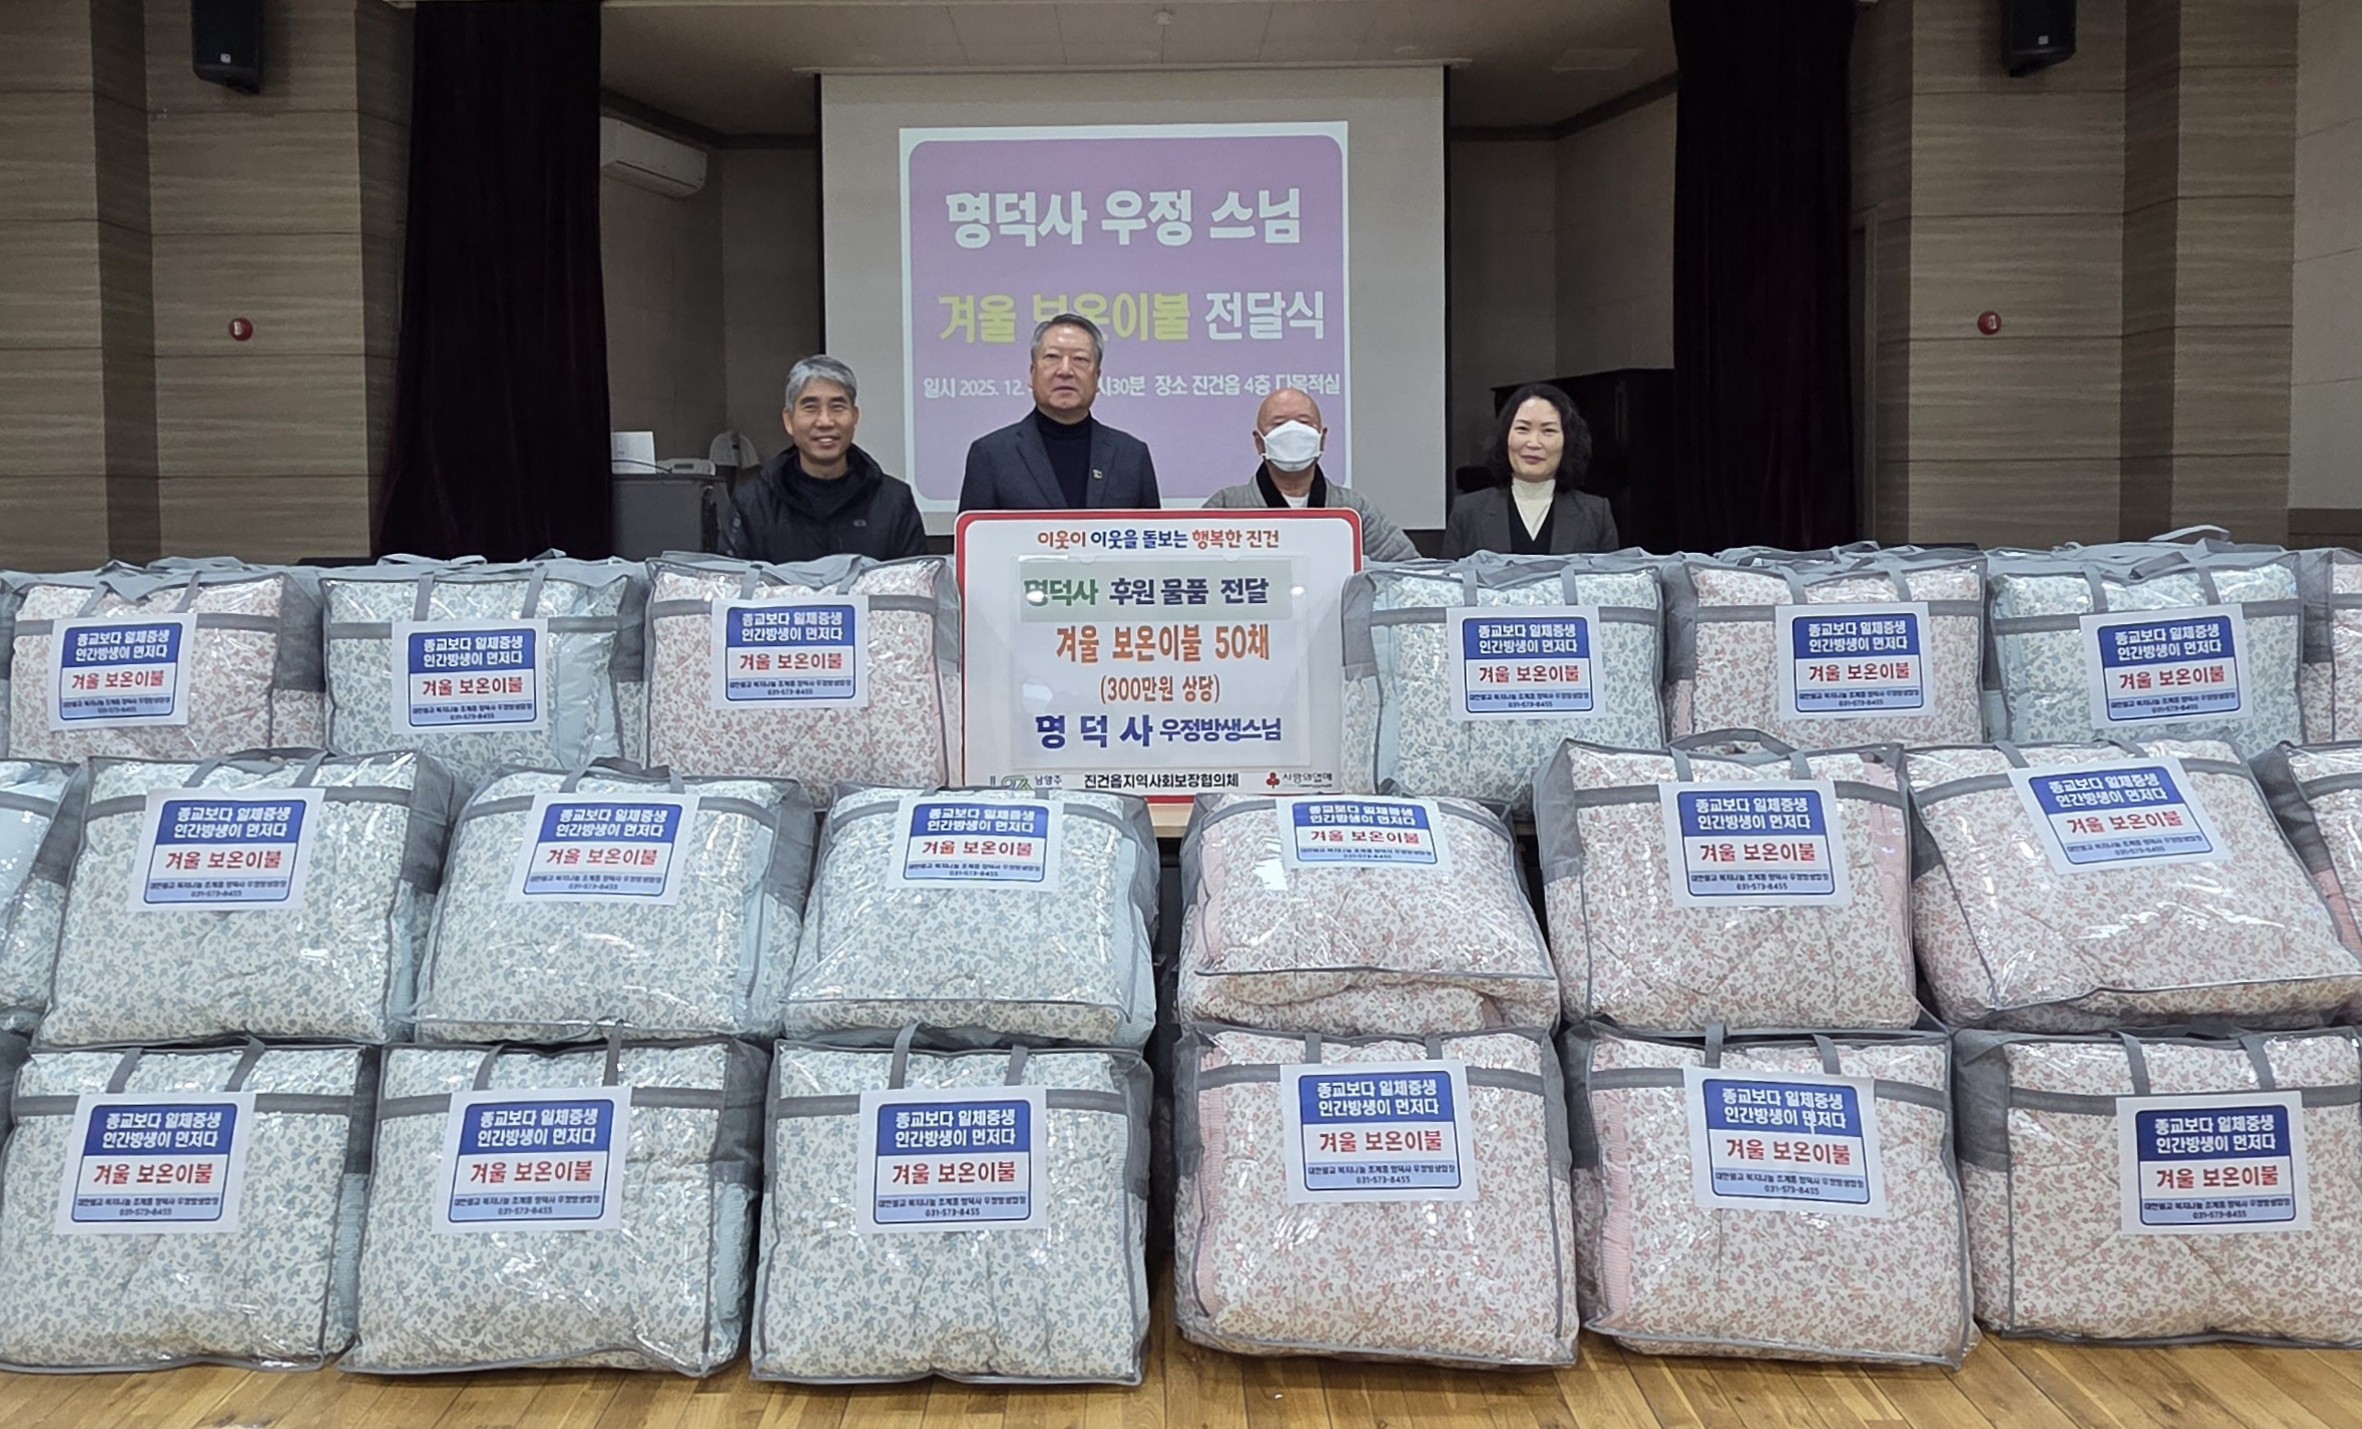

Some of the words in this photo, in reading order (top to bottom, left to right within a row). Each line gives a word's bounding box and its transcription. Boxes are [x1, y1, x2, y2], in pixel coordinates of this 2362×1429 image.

[946, 191, 1087, 248] 명덕사
[1101, 190, 1192, 245] 우정
[1210, 188, 1300, 244] 스님
[939, 294, 1016, 343] 겨울
[1205, 291, 1324, 340] 전달식
[924, 377, 955, 398] 일시
[960, 380, 999, 397] 2025.
[1155, 375, 1188, 396] 장소
[1192, 374, 1240, 396] 진건읍
[1244, 374, 1271, 396] 4층
[1038, 531, 1086, 548] 이웃이
[1091, 530, 1139, 549] 이웃을
[1142, 531, 1188, 549] 돌보는
[1192, 529, 1242, 549] 행복한
[1246, 529, 1280, 548] 진건
[1024, 579, 1099, 606] 명덕사
[1109, 578, 1155, 605] 후원
[1161, 578, 1209, 605] 물품
[1220, 578, 1269, 604] 전달
[741, 612, 790, 627] 종교보다
[793, 610, 842, 625] 일체중생
[1808, 622, 1856, 637] 종교보다
[1859, 620, 1907, 635] 일체중생
[741, 627, 801, 642] 인간방생이
[805, 626, 842, 640] 먼저다
[1478, 624, 1526, 638] 종교보다
[1529, 623, 1576, 637] 일체중생
[2115, 627, 2166, 645] 종교보다
[2169, 623, 2220, 640] 일체중생
[423, 637, 471, 652] 종교보다
[475, 634, 522, 650] 일체중생
[1056, 625, 1099, 662] 겨울
[1113, 624, 1202, 662] 보온이불
[1215, 623, 1270, 660] 50채
[1478, 639, 1538, 653] 인간방생이
[1542, 638, 1578, 652] 먼저다
[1809, 637, 1869, 652] 인간방생이
[1872, 635, 1908, 650] 먼저다
[2116, 642, 2180, 661] 인간방생이
[2183, 638, 2222, 655] 먼저다
[423, 651, 482, 667] 인간방생이
[487, 649, 523, 665] 먼저다
[740, 653, 770, 670] 겨울
[777, 651, 842, 669] 보온이불
[71, 672, 100, 689] 겨울
[105, 669, 165, 688] 보온이불
[1479, 665, 1509, 682] 겨울
[1516, 664, 1579, 682] 보온이불
[1809, 664, 1840, 681] 겨울
[1846, 661, 1909, 680] 보온이불
[2119, 671, 2152, 690] 겨울
[2158, 664, 2224, 687] 보온이불
[423, 678, 452, 696] 겨울
[459, 675, 522, 694] 보온이불
[1101, 675, 1173, 704] (300만원
[1182, 674, 1220, 703] 상당)
[1160, 718, 1281, 743] 우정방생스님
[1084, 774, 1239, 788] 진건읍지역사회보장협의체
[2046, 777, 2105, 793] 종교보다
[1695, 797, 1750, 813] 종교보다
[1753, 796, 1808, 812] 일체중생
[2054, 790, 2125, 807] 인간방생이
[2123, 786, 2169, 801] 먼저다
[176, 807, 233, 822] 종교보다
[234, 806, 291, 821] 일체중생
[558, 809, 612, 822] 종교보다
[1697, 814, 1766, 830] 인간방생이
[1769, 813, 1811, 829] 먼저다
[2065, 816, 2106, 834] 겨울
[2106, 809, 2184, 831] 보온이불
[173, 823, 243, 838] 인간방생이
[245, 822, 288, 837] 먼저다
[554, 823, 621, 836] 인간방생이
[622, 823, 665, 836] 먼저다
[546, 848, 582, 864] 겨울
[585, 848, 658, 865] 보온이불
[922, 840, 956, 854] 겨울
[962, 841, 1032, 855] 보온이불
[1699, 843, 1736, 861] 겨울
[1742, 842, 1816, 861] 보온이불
[165, 851, 202, 869] 겨울
[207, 850, 282, 869] 보온이불
[1317, 1080, 1375, 1098] 종교보다
[1378, 1078, 1437, 1096] 일체중생
[1722, 1087, 1782, 1106] 종교보다
[1784, 1090, 1844, 1109] 일체중생
[1318, 1099, 1391, 1117] 인간방생이
[1394, 1097, 1439, 1115] 먼저다
[1723, 1106, 1798, 1126] 인간방생이
[1801, 1109, 1847, 1128] 먼저다
[104, 1112, 162, 1129] 종교보다
[163, 1110, 222, 1128] 일체중생
[479, 1109, 537, 1128] 종교보다
[539, 1107, 599, 1125] 일체중생
[895, 1110, 953, 1129] 종교보다
[957, 1108, 1015, 1126] 일체중생
[2154, 1116, 2213, 1135] 종교보다
[2217, 1114, 2275, 1132] 일체중생
[101, 1131, 172, 1148] 인간방생이
[174, 1130, 219, 1147] 먼저다
[476, 1128, 548, 1147] 인간방생이
[551, 1126, 597, 1144] 먼저다
[895, 1129, 967, 1148] 인간방생이
[972, 1127, 1016, 1145] 먼저다
[1319, 1131, 1356, 1152] 겨울
[1364, 1129, 1442, 1151] 보온이불
[2155, 1134, 2228, 1154] 인간방생이
[2232, 1133, 2276, 1151] 먼저다
[1726, 1137, 1764, 1160] 겨울
[1771, 1140, 1850, 1164] 보온이불
[93, 1163, 131, 1184] 겨울
[136, 1162, 213, 1184] 보온이불
[470, 1161, 508, 1183] 겨울
[514, 1159, 593, 1182] 보온이불
[892, 1162, 929, 1184] 겨울
[938, 1160, 1015, 1183] 보온이불
[2156, 1167, 2194, 1189] 겨울
[2201, 1164, 2278, 1187] 보온이불
